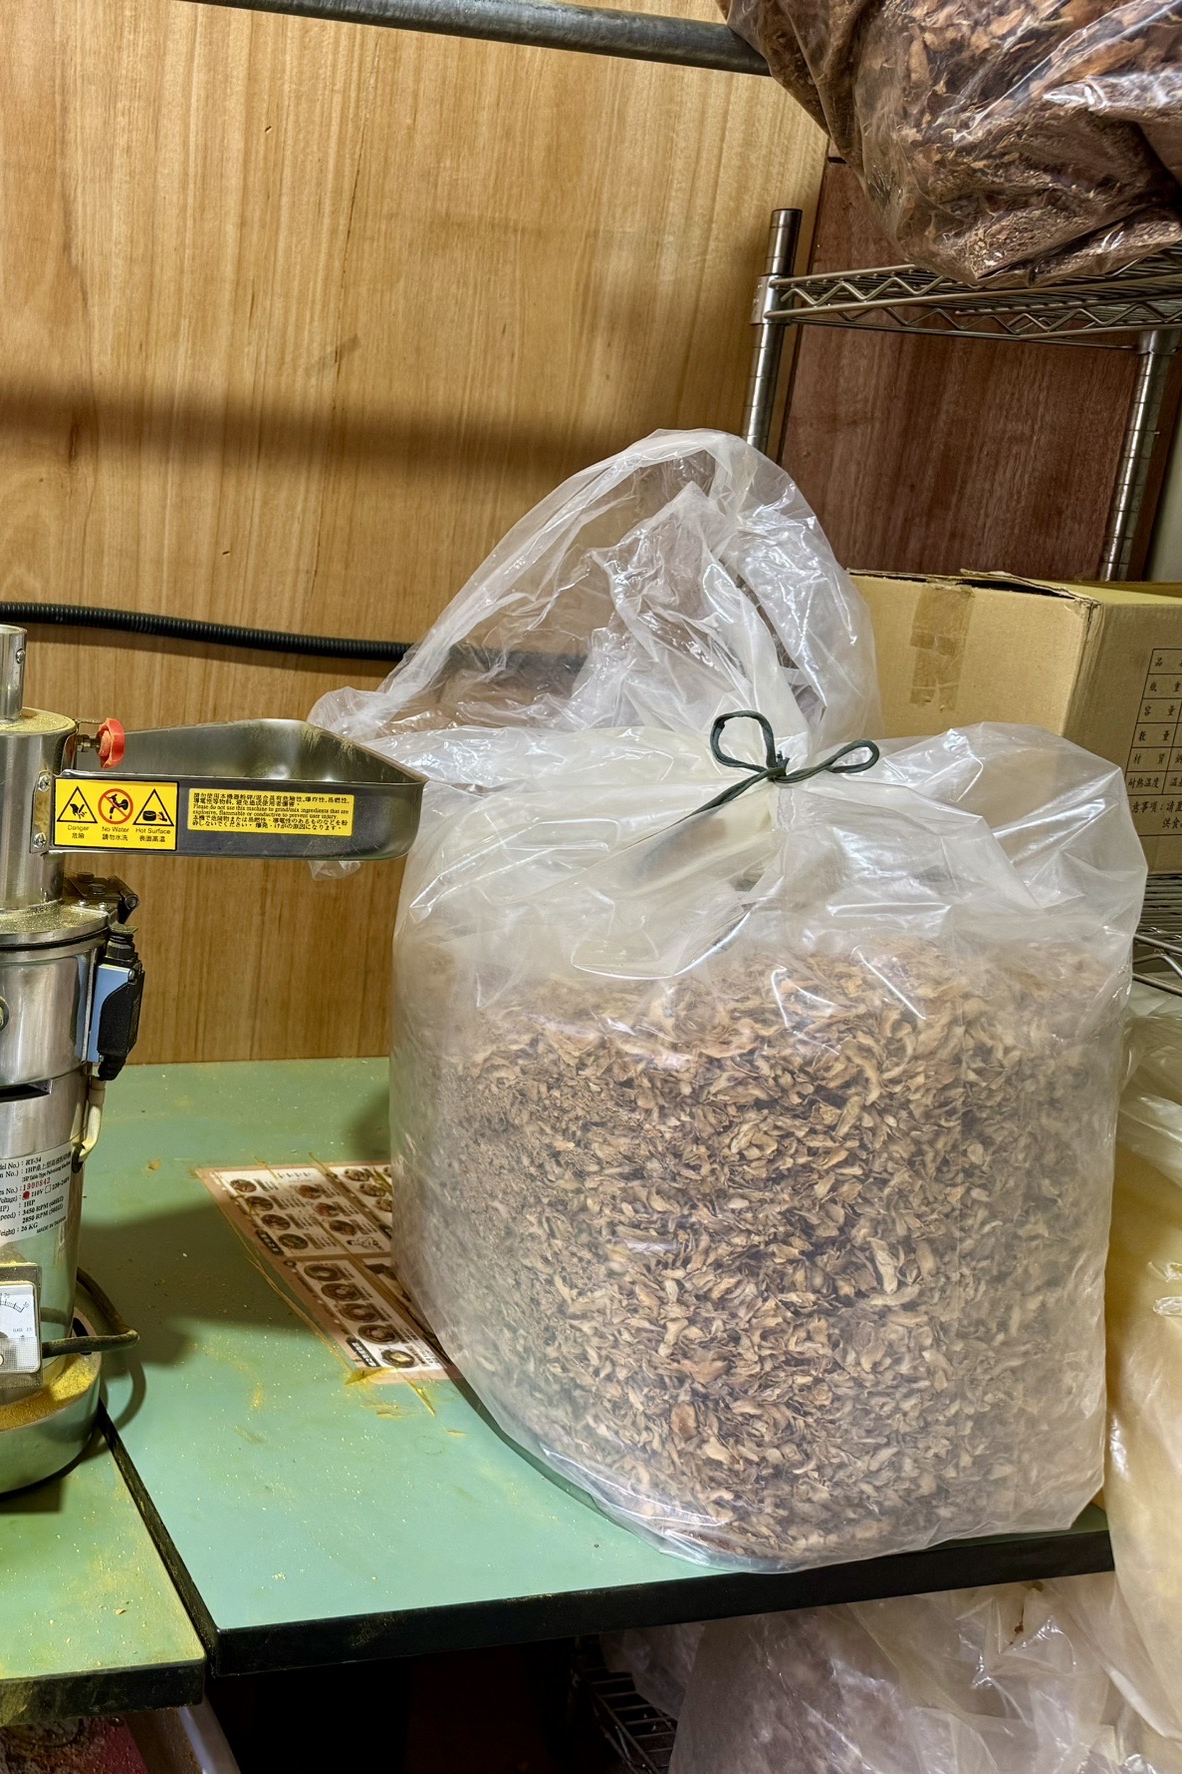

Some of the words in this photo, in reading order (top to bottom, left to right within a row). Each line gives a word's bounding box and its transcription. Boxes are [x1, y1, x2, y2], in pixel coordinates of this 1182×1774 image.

[6, 1170, 18, 1178] No.)
[36, 1202, 48, 1210] RPM
[36, 1210, 48, 1220] RPM
[28, 1222, 38, 1230] KG
